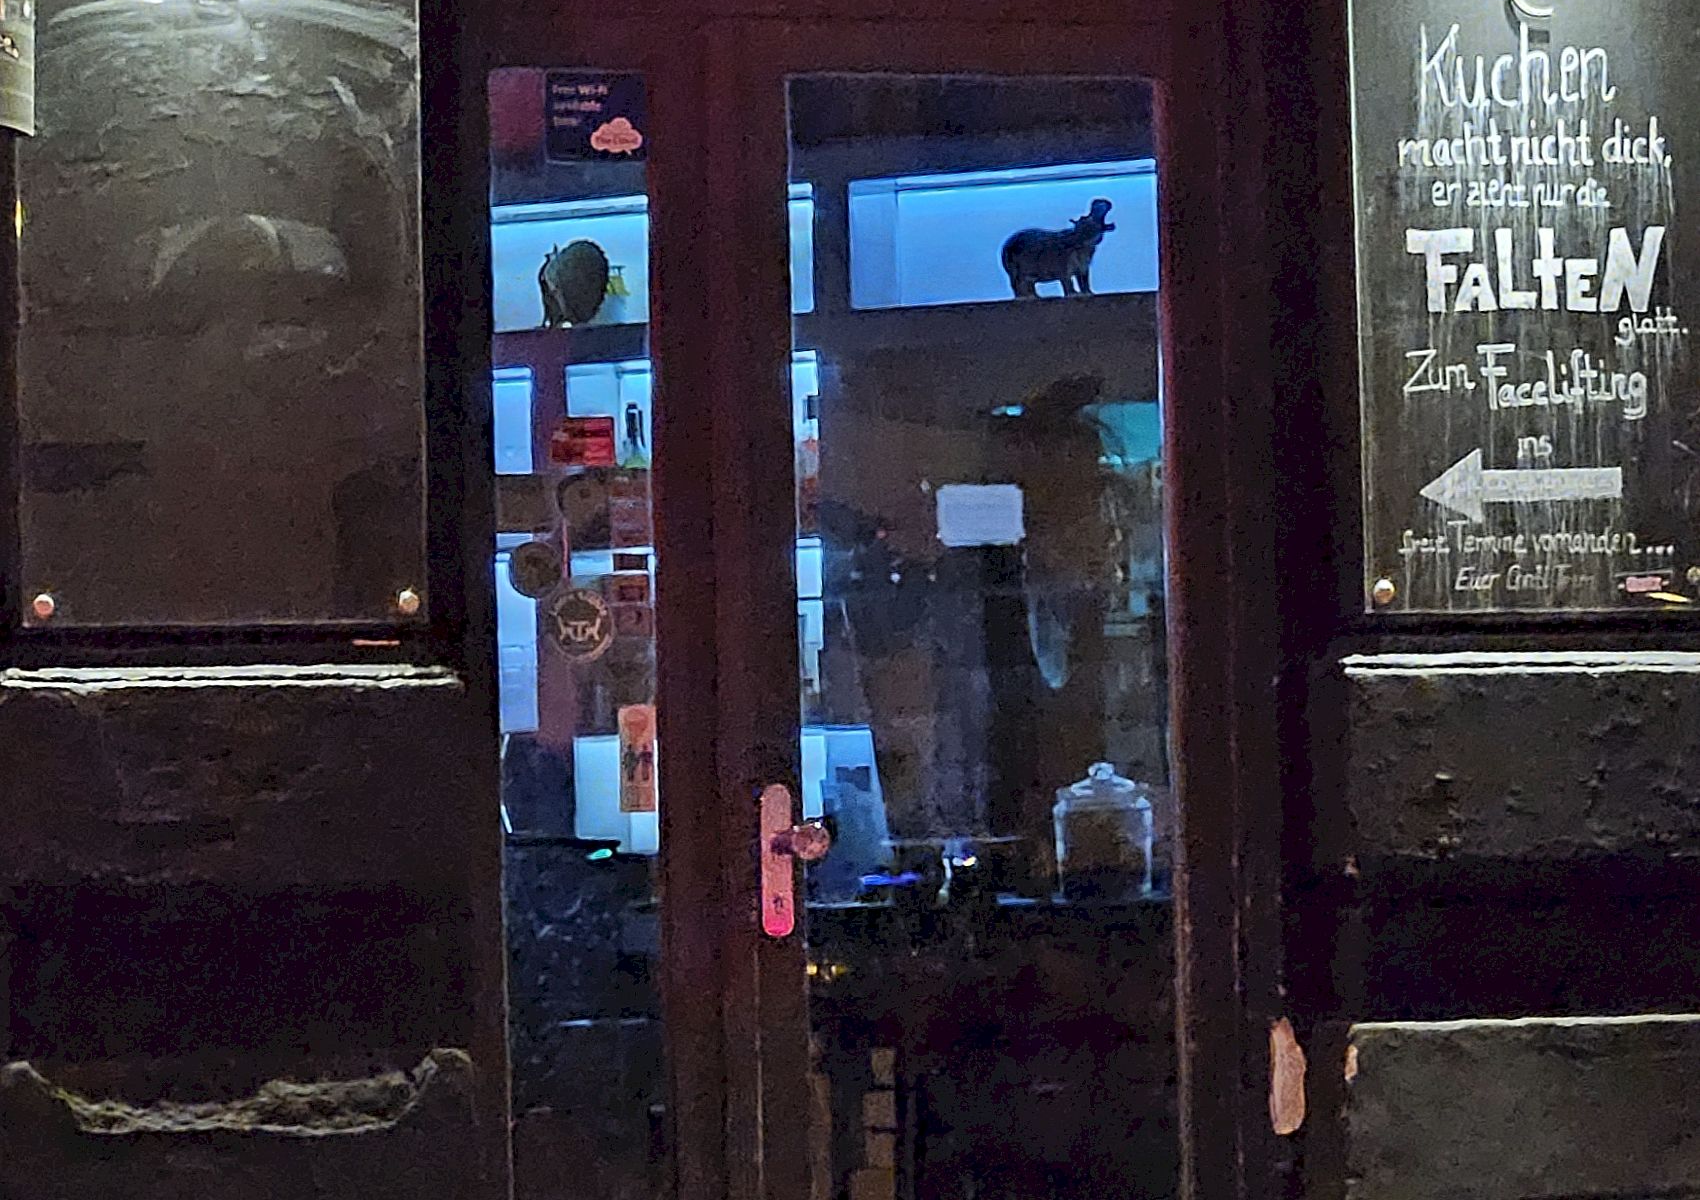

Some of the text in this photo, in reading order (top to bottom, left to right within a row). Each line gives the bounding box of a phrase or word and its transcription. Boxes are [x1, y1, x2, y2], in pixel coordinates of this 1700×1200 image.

[1418, 22, 1618, 110] Kuchen
[1398, 117, 1507, 168] macht
[1510, 118, 1595, 168] nicht
[1431, 179, 1462, 207] er
[1533, 180, 1575, 208] nur
[1576, 176, 1612, 208] die
[1402, 343, 1649, 421] Zum Facelifting
[1447, 520, 1528, 556] Termine
[1454, 566, 1500, 592] Euer
